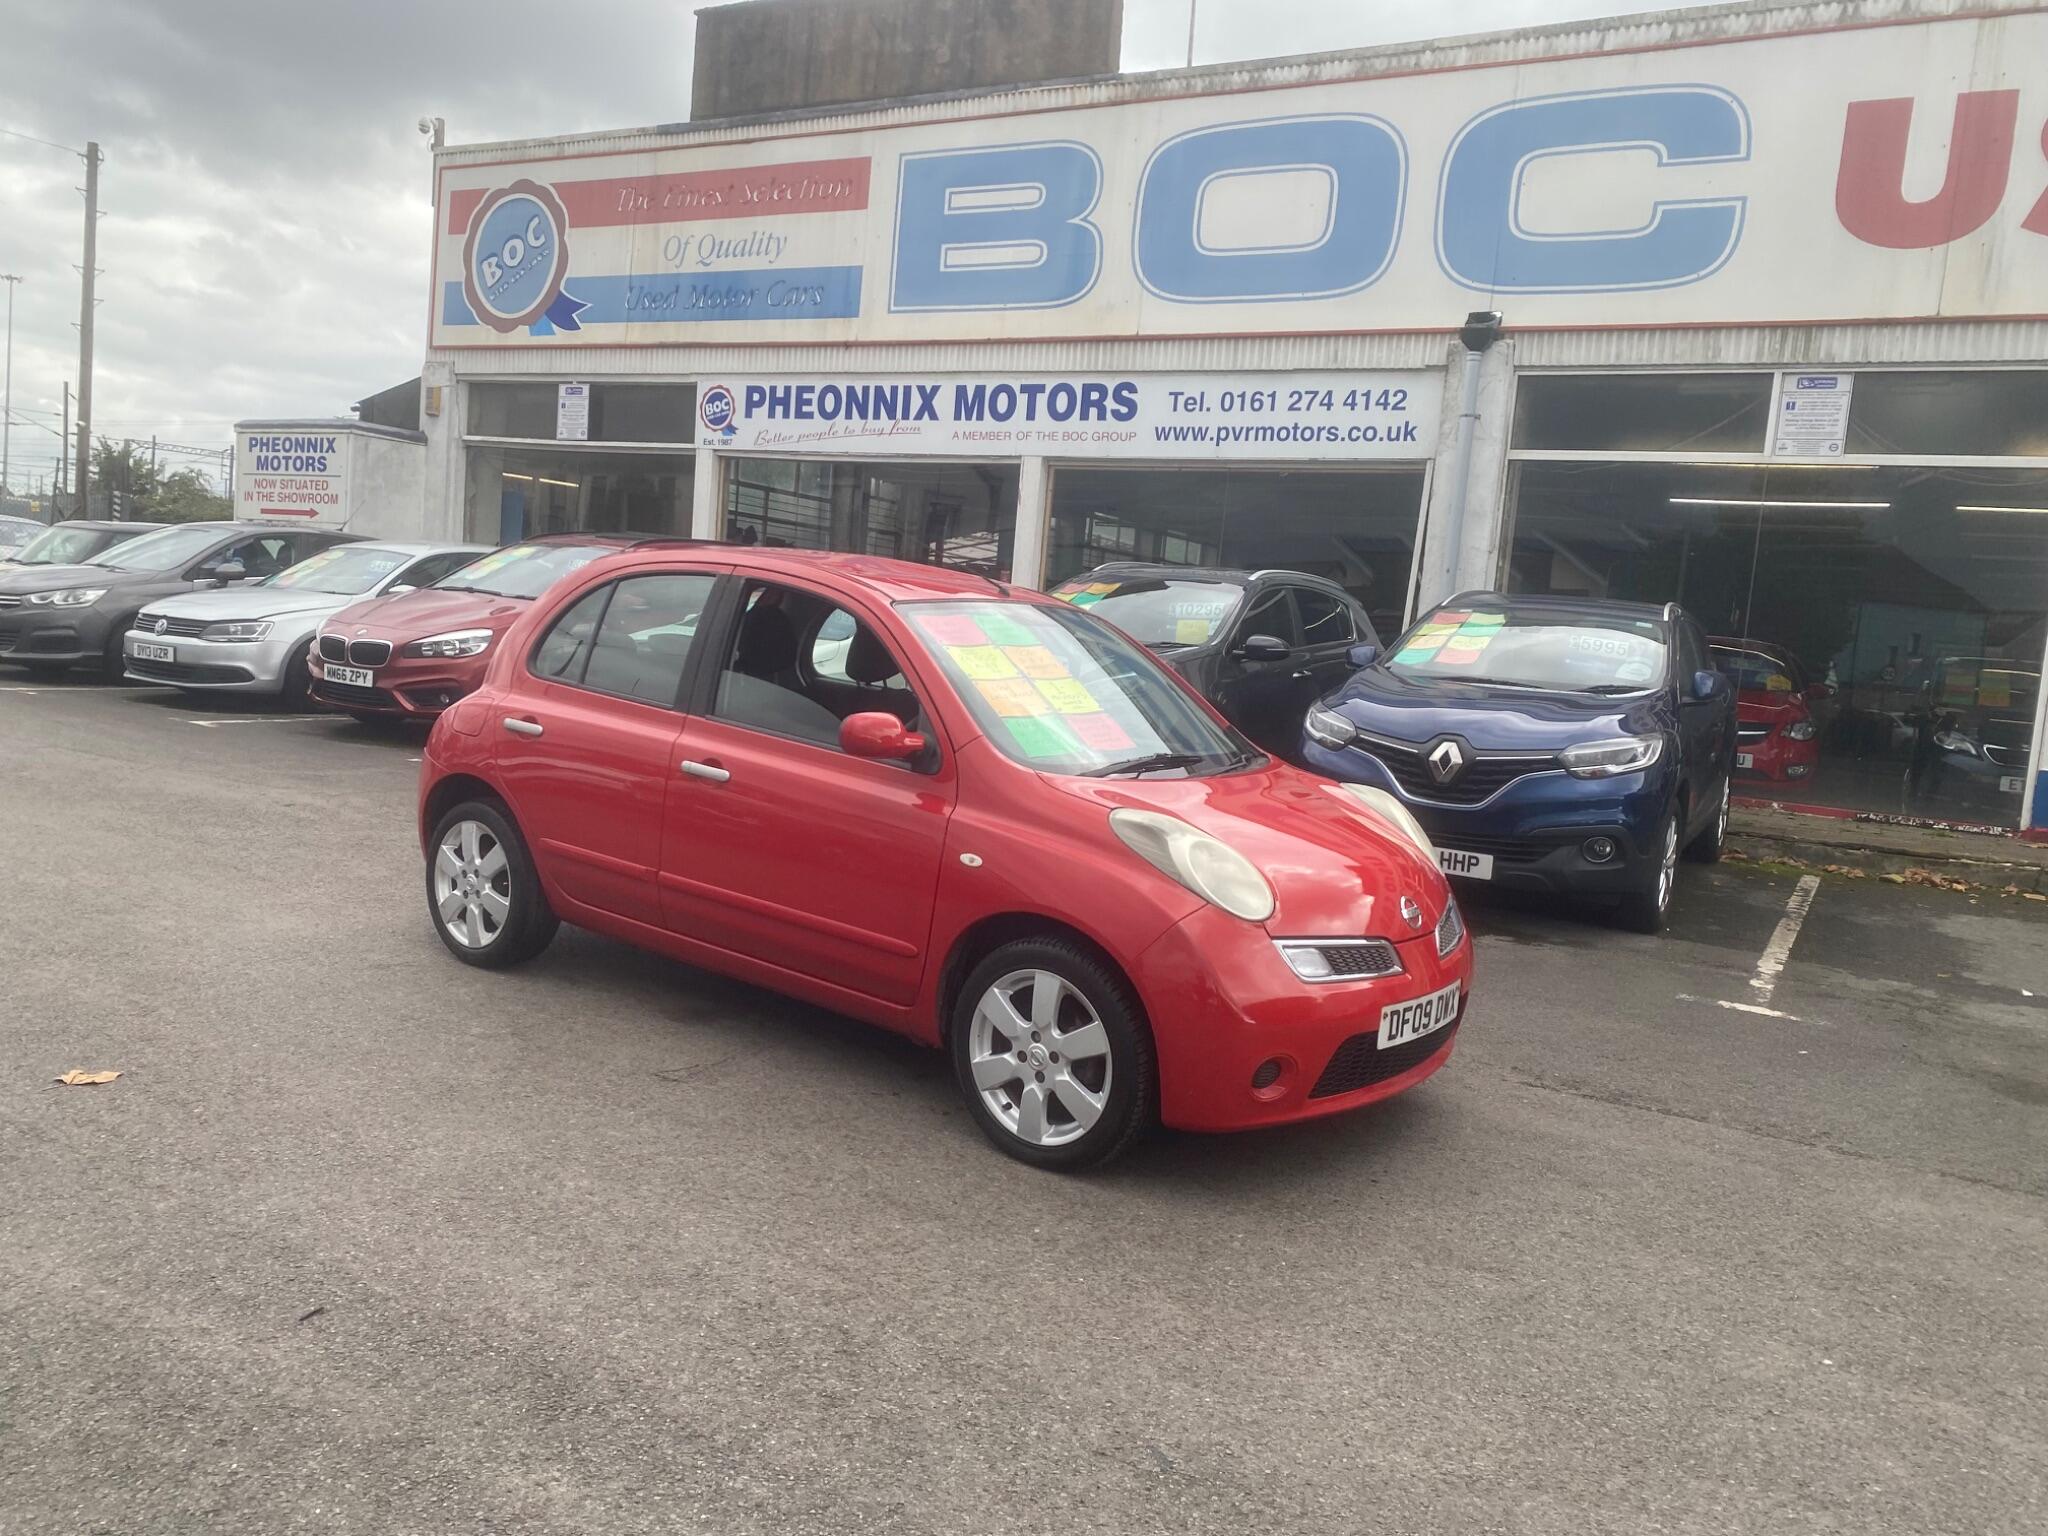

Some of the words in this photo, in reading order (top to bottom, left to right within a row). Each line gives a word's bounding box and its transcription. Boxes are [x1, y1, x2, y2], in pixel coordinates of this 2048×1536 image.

[617, 186, 654, 212] The
[739, 175, 854, 205] Selection
[888, 83, 1752, 313] BOC
[1836, 88, 2048, 249] U
[481, 214, 546, 289] BOC
[663, 234, 694, 270] Of
[696, 230, 788, 267] Quality
[624, 283, 680, 312] Used
[683, 283, 760, 311] Motor
[767, 279, 825, 308] Cars
[705, 398, 730, 416] BOC
[744, 383, 942, 422] PHEONNIX
[953, 381, 1139, 423] MOTORS
[1168, 391, 1212, 413] Tel.
[1220, 391, 1278, 413] 0161
[1287, 390, 1335, 412] 274
[1342, 389, 1408, 412] 4142
[754, 429, 794, 446] Better
[797, 421, 839, 443] people
[843, 422, 856, 435] to
[860, 420, 885, 437] buy
[888, 418, 921, 437] from
[952, 431, 960, 441] A
[962, 431, 1012, 441] MEMBER
[1016, 432, 1033, 441] OF
[1035, 431, 1059, 442] THE
[1062, 431, 1089, 442] BOC
[1091, 431, 1137, 442] GROUP
[1154, 420, 1418, 447] www.pvrmotors.co.uk
[248, 436, 337, 454] PHEONNIX
[256, 455, 328, 473] MOTORS
[253, 478, 278, 490] NOW
[279, 478, 329, 491] SITUATED
[244, 491, 254, 502] IN
[256, 491, 276, 503] THE
[277, 492, 339, 505] SHOWROOM
[152, 647, 169, 660] UZR
[349, 670, 368, 685] ZPY
[1440, 850, 1480, 873] HHP
[1387, 998, 1433, 1042] DF09
